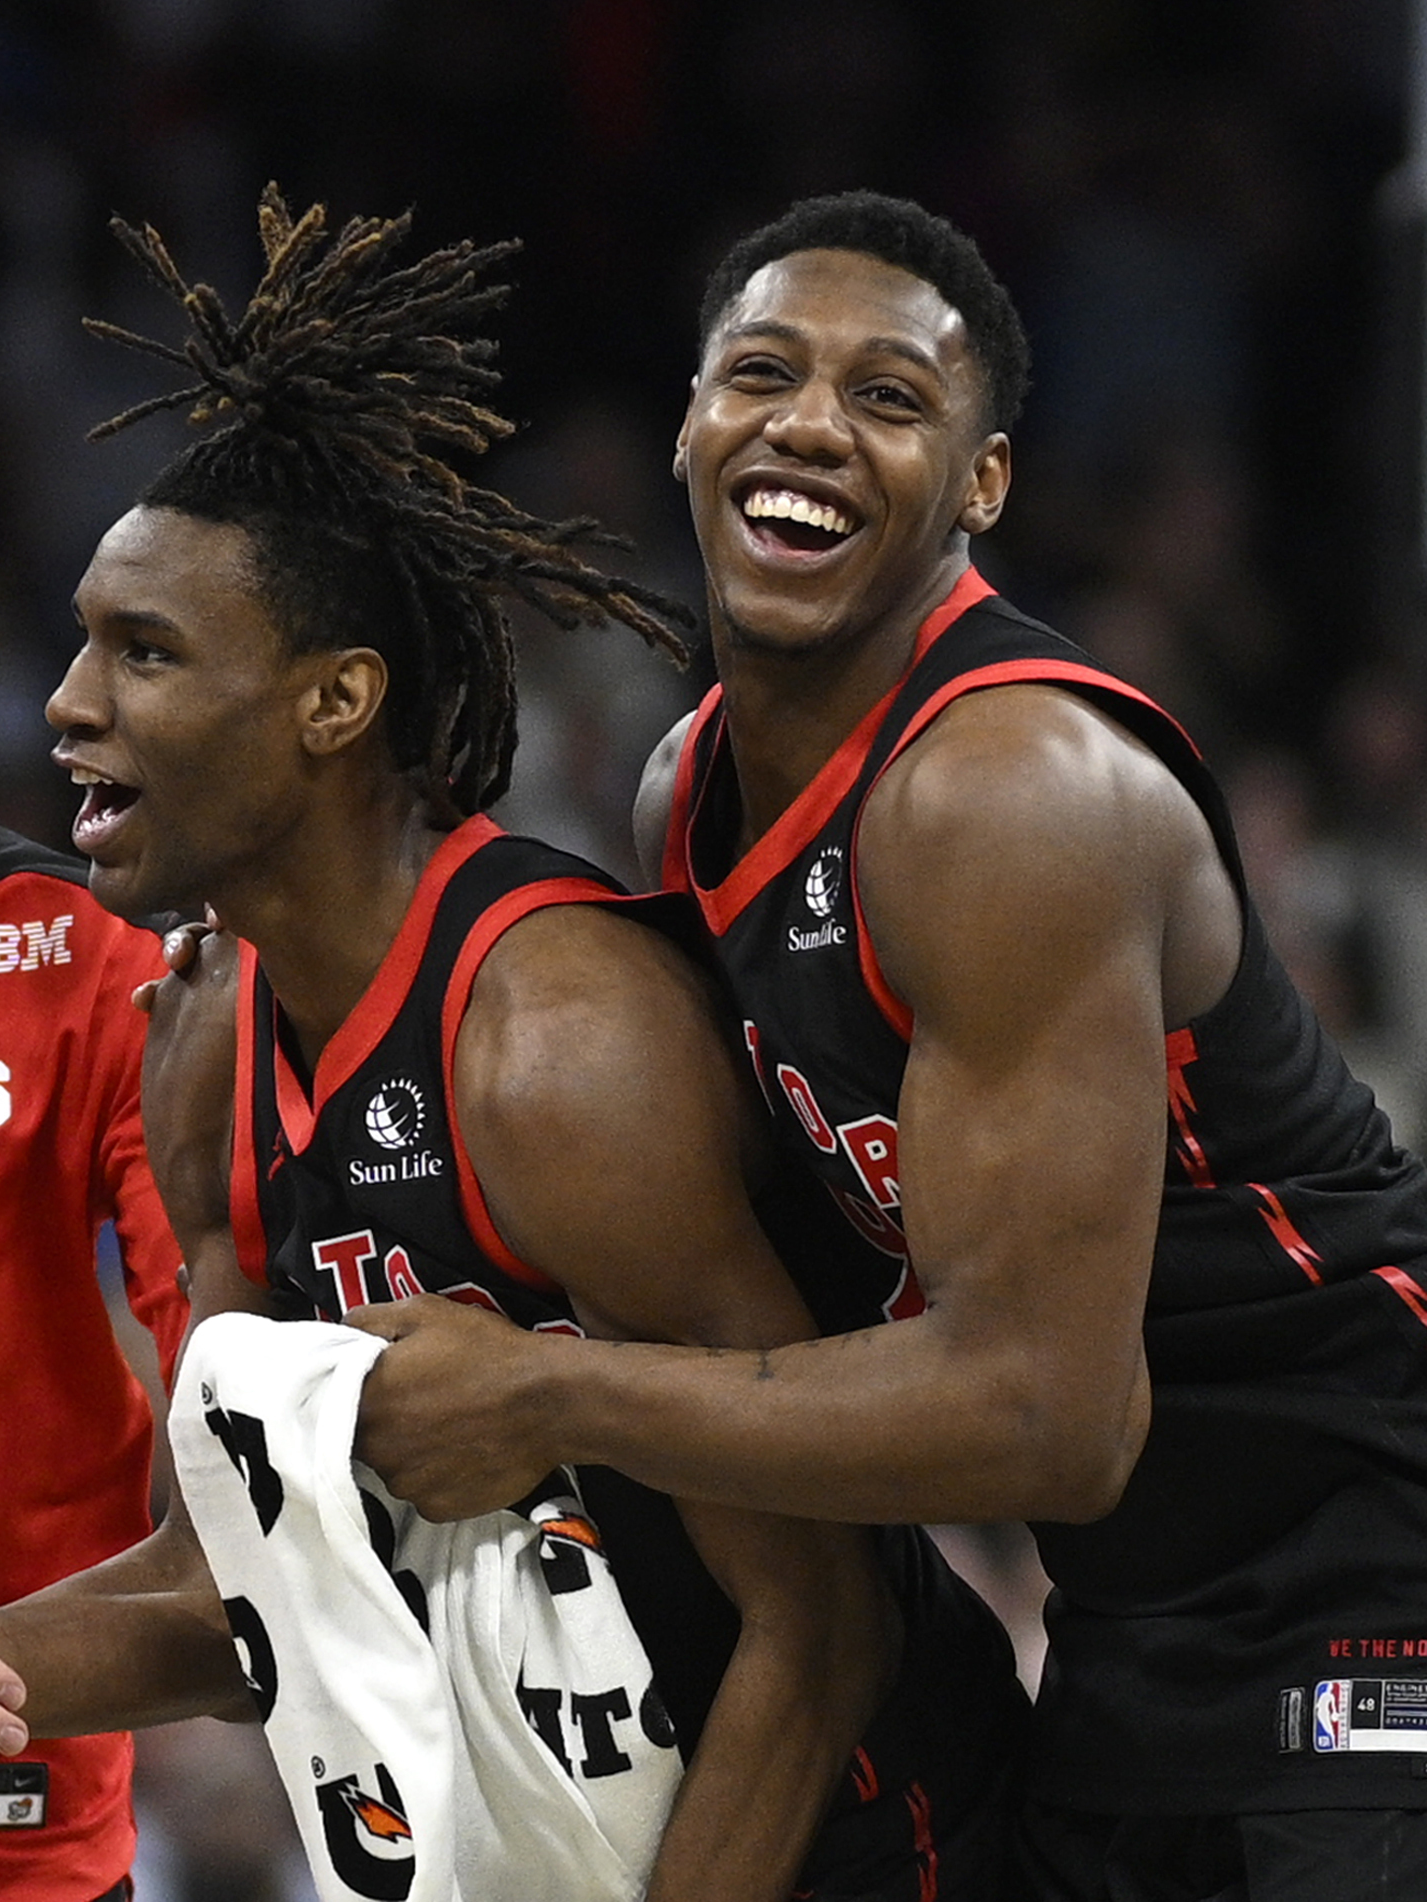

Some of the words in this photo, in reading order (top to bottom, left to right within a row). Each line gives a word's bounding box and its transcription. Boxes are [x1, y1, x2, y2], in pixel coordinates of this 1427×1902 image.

[349, 1159, 397, 1186] Sun
[401, 1149, 444, 1181] Life
[1359, 1639, 1397, 1658] THE
[1357, 1697, 1376, 1711] 48
